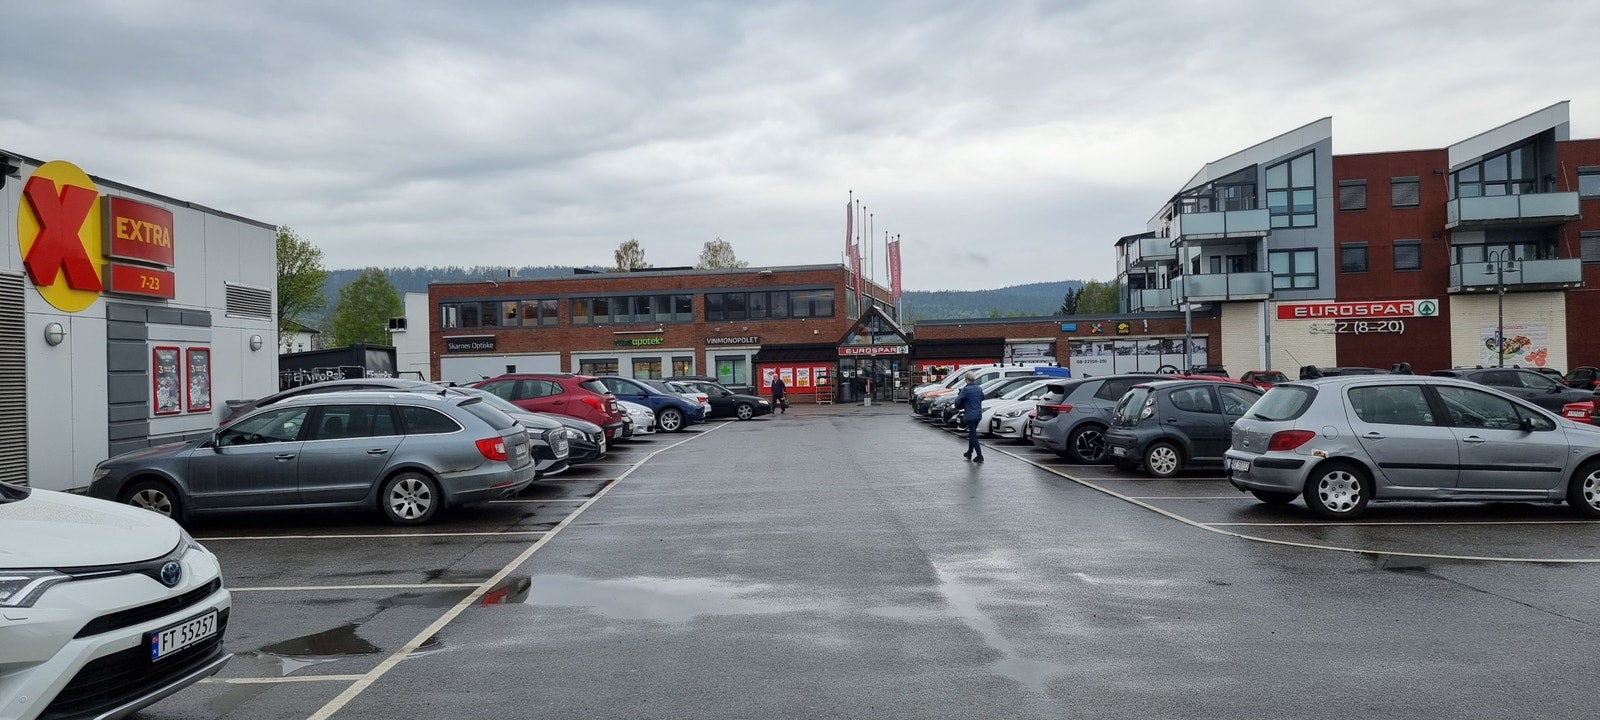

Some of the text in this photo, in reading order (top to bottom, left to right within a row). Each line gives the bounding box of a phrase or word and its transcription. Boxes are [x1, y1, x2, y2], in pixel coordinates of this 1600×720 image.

[116, 216, 171, 249] EXTRA
[140, 275, 160, 291] 7-23
[1294, 303, 1414, 317] EUROSPAR
[1354, 320, 1405, 335] (8-20)
[448, 341, 494, 350] Skarnes Optiske
[706, 336, 758, 344] VINMONOPOLET
[162, 615, 214, 651] FT 55257
